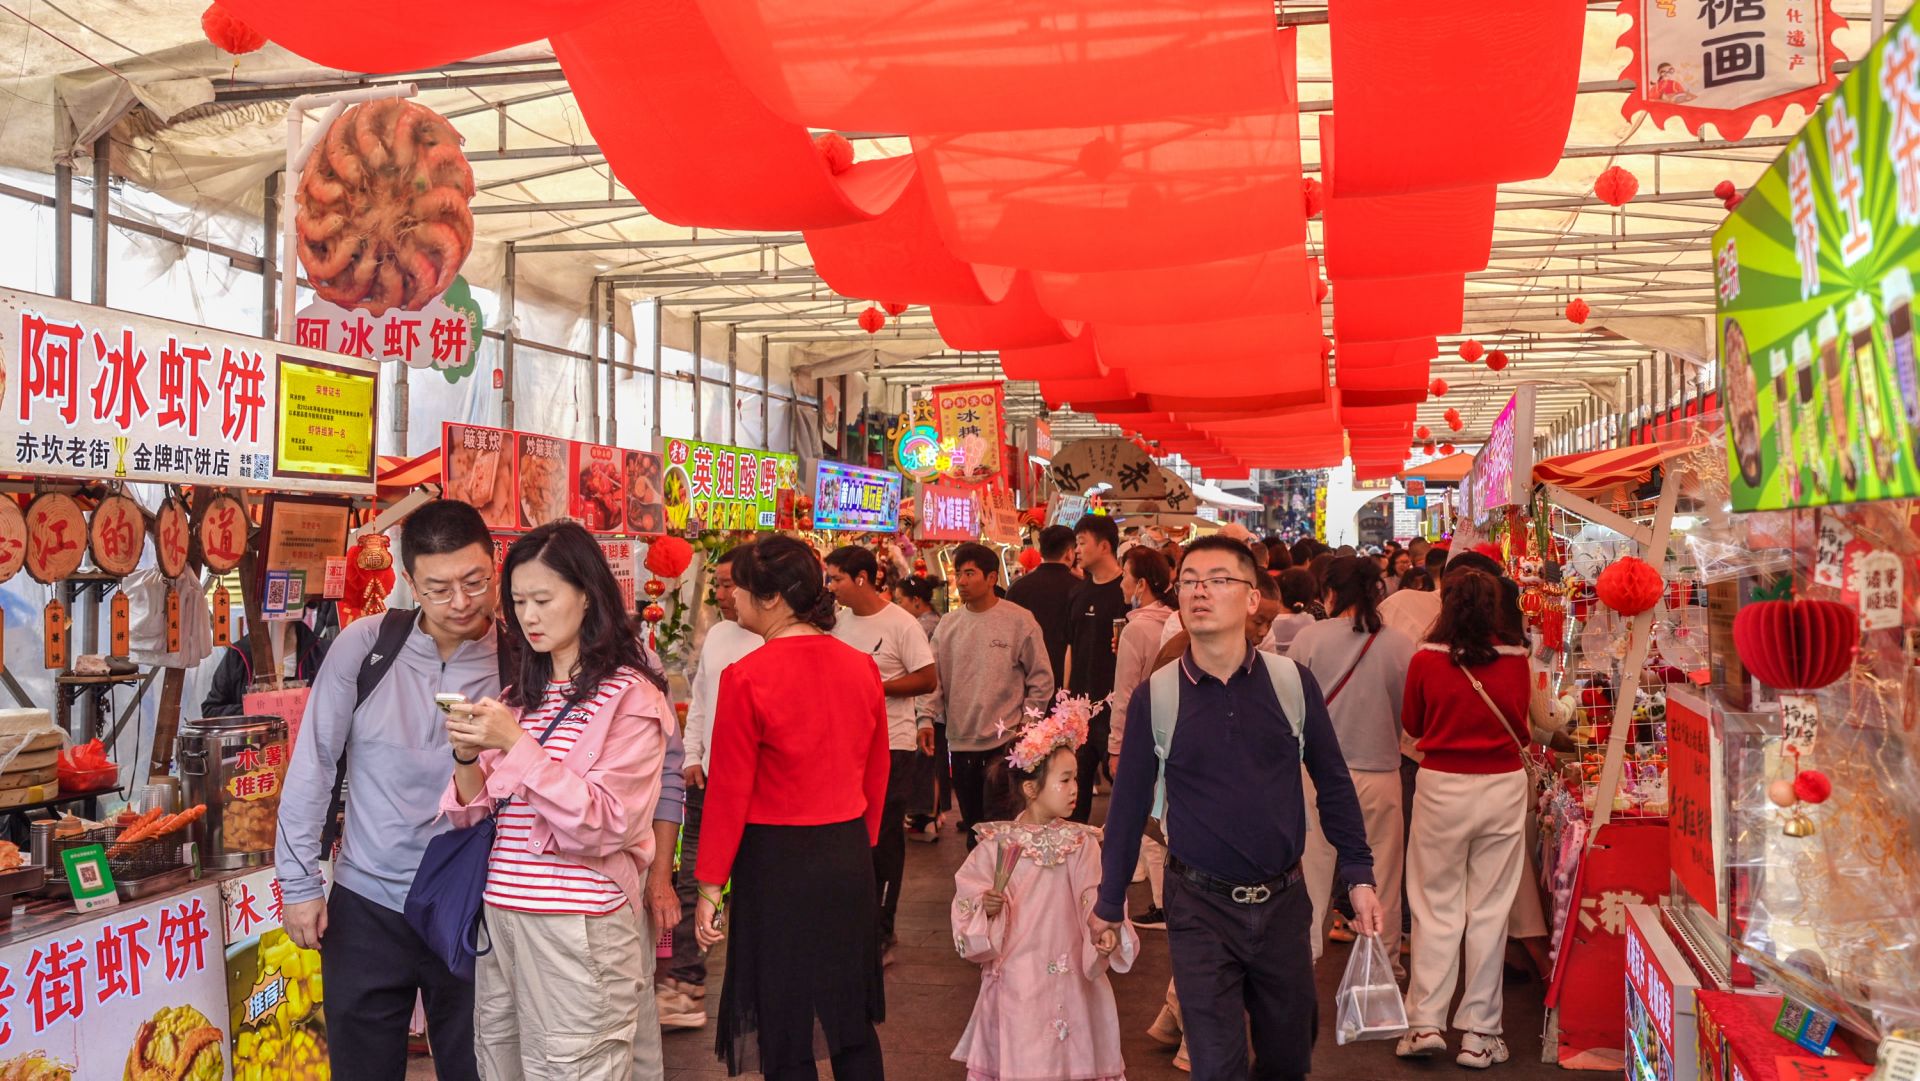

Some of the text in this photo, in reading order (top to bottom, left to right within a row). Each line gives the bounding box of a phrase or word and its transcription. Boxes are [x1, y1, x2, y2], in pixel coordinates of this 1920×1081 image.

[296, 317, 467, 362] 阿冰虾饼
[19, 310, 267, 445] 阿冰虾饼
[16, 433, 230, 477] 赤坎老街 金牌虾饼店
[692, 446, 777, 501] 英姐酸嘢
[235, 745, 282, 770] 木薯
[236, 771, 276, 797] 推荐
